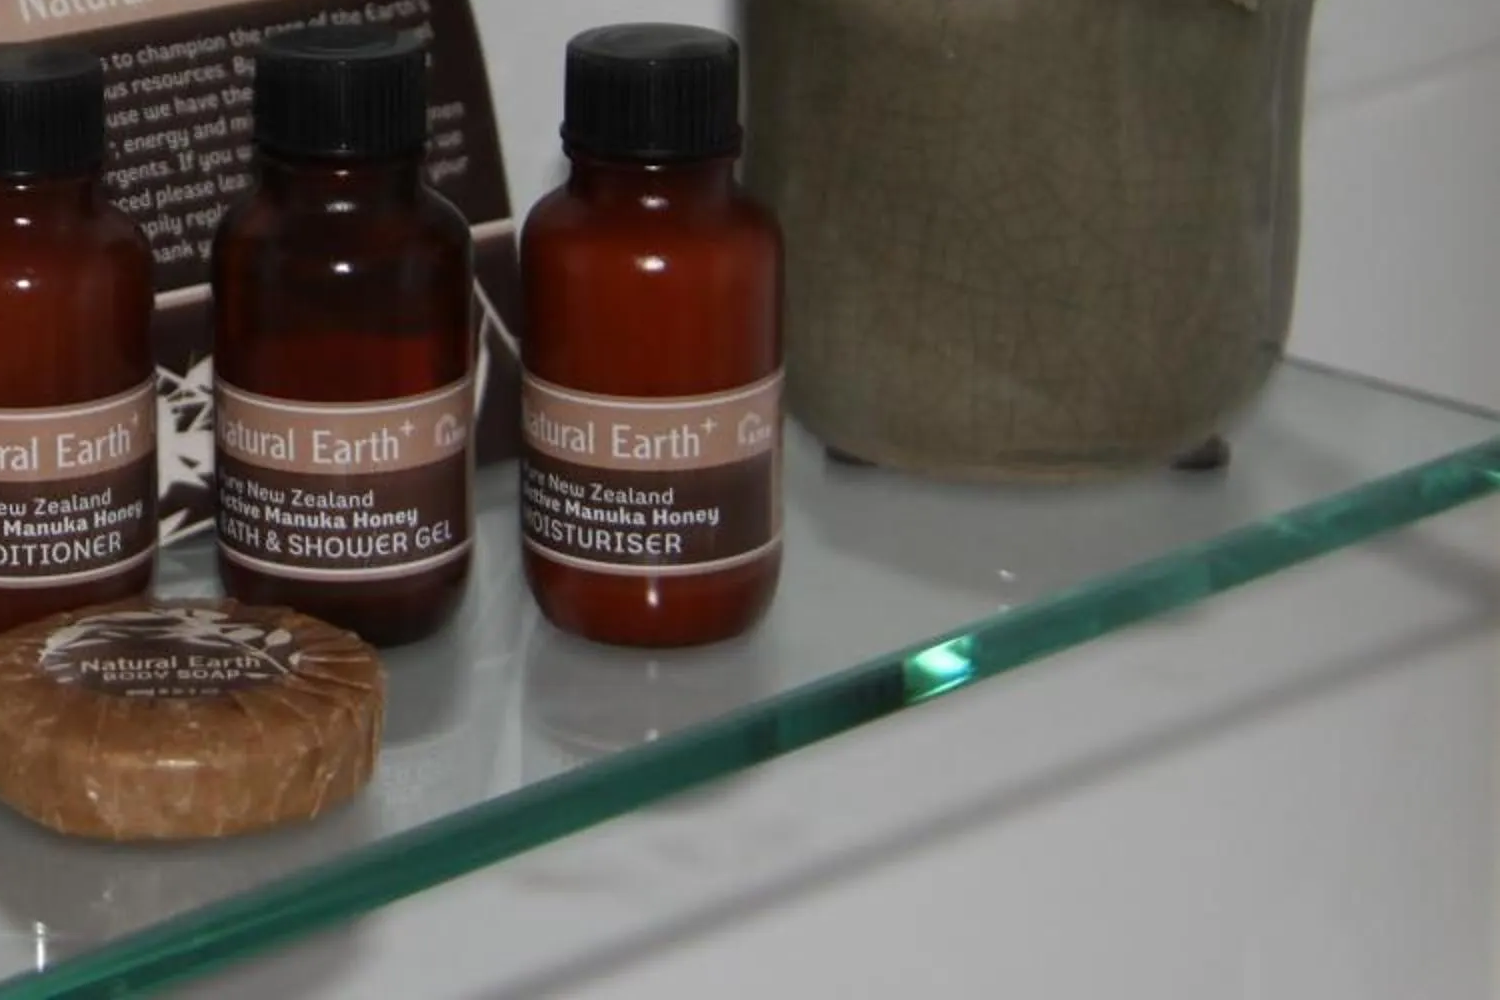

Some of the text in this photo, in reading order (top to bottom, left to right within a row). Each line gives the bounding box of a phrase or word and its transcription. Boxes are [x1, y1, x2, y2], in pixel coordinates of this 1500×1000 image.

[112, 52, 134, 70] to
[136, 35, 227, 60] champion
[229, 28, 262, 47] the
[143, 103, 172, 121] we
[174, 94, 219, 114] have
[221, 84, 254, 105] the
[124, 128, 190, 153] energy
[193, 116, 227, 140] and
[177, 150, 194, 171] If
[199, 149, 233, 172] you
[156, 180, 215, 209] please
[218, 174, 251, 193] lea
[186, 202, 228, 229] repl
[524, 412, 595, 455] atural
[34, 487, 112, 515] Zealand
[247, 481, 285, 503] New
[291, 489, 374, 508] Zealand
[549, 473, 586, 498] New
[590, 483, 674, 505] Zealand
[3, 517, 88, 537] Manuka
[93, 501, 144, 529] Honey
[265, 507, 347, 529] Manuka
[353, 507, 419, 528] Honey
[565, 499, 646, 526] Manuka
[652, 507, 720, 527] Honey
[265, 531, 282, 553] &
[288, 531, 408, 559] SHOWER
[415, 520, 454, 549] GEL
[81, 655, 261, 673] Natural Earth
[103, 669, 241, 681] BODY SOAP
